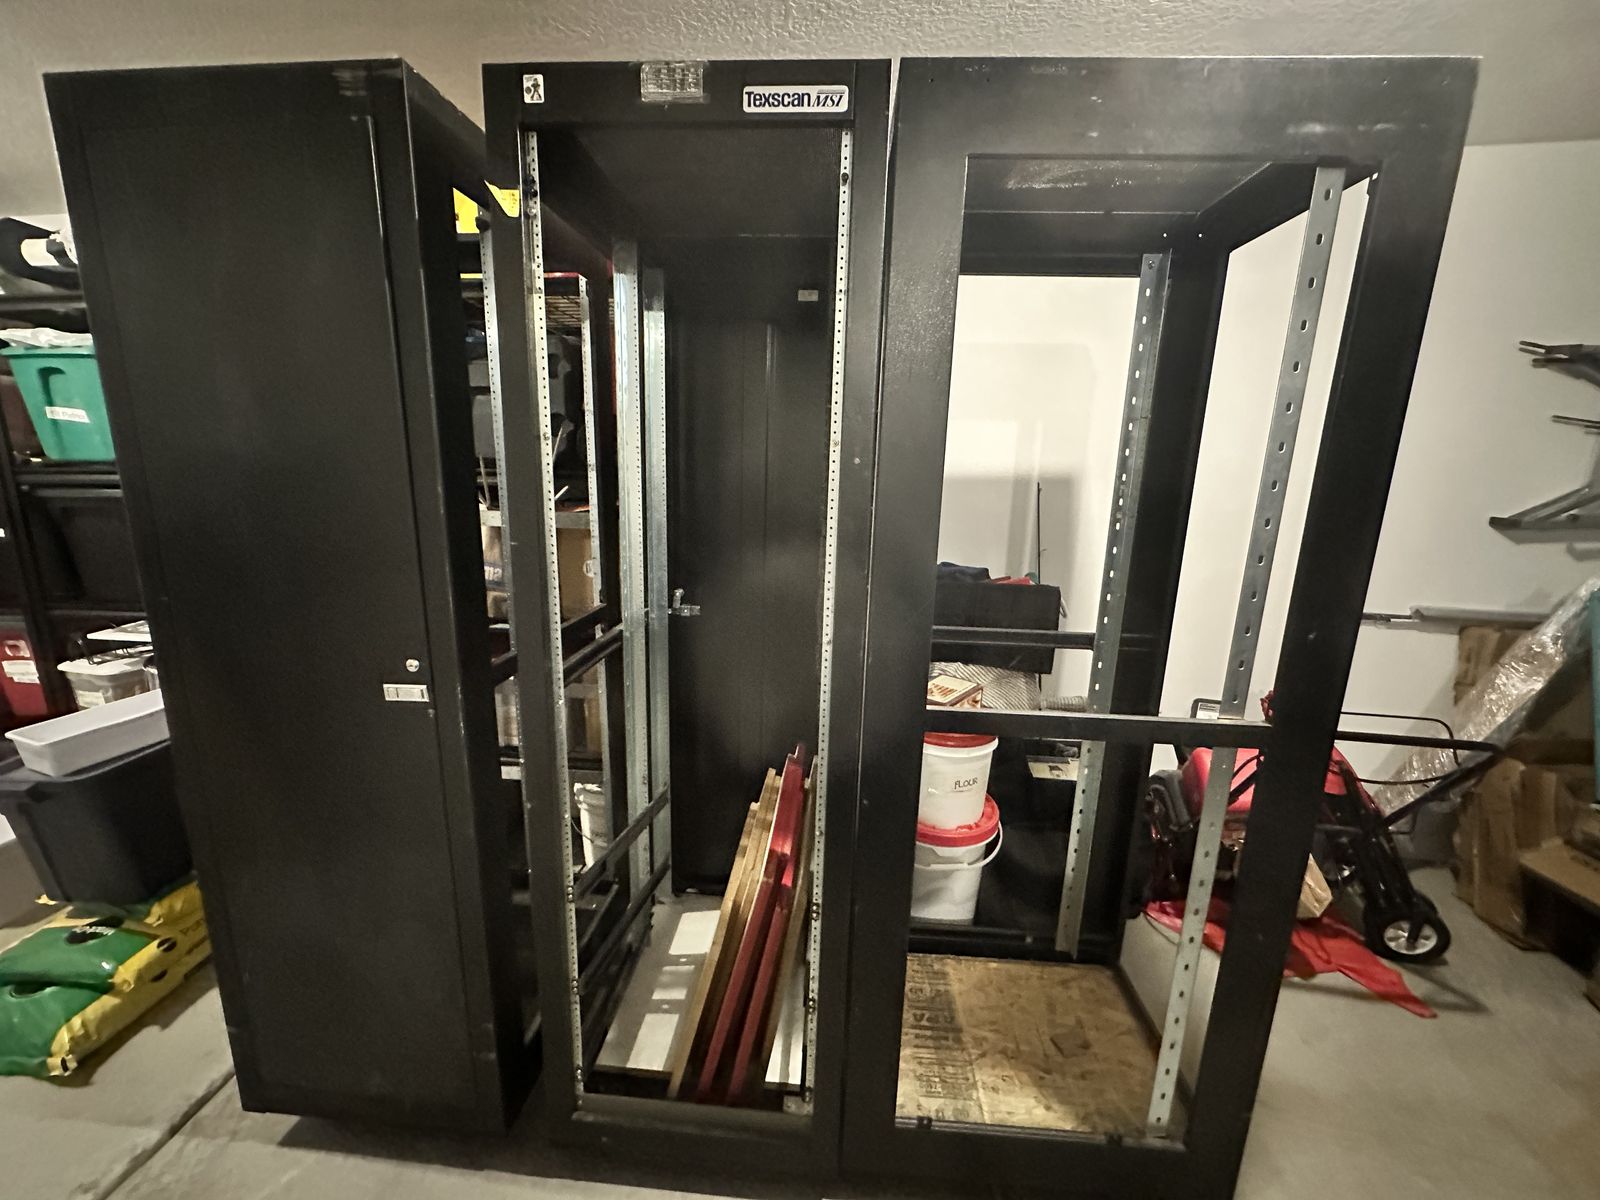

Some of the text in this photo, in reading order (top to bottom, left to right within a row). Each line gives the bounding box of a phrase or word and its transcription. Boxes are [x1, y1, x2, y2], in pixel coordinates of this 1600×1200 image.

[745, 91, 844, 107] Texscan MSI
[954, 777, 978, 790] FLOUR
